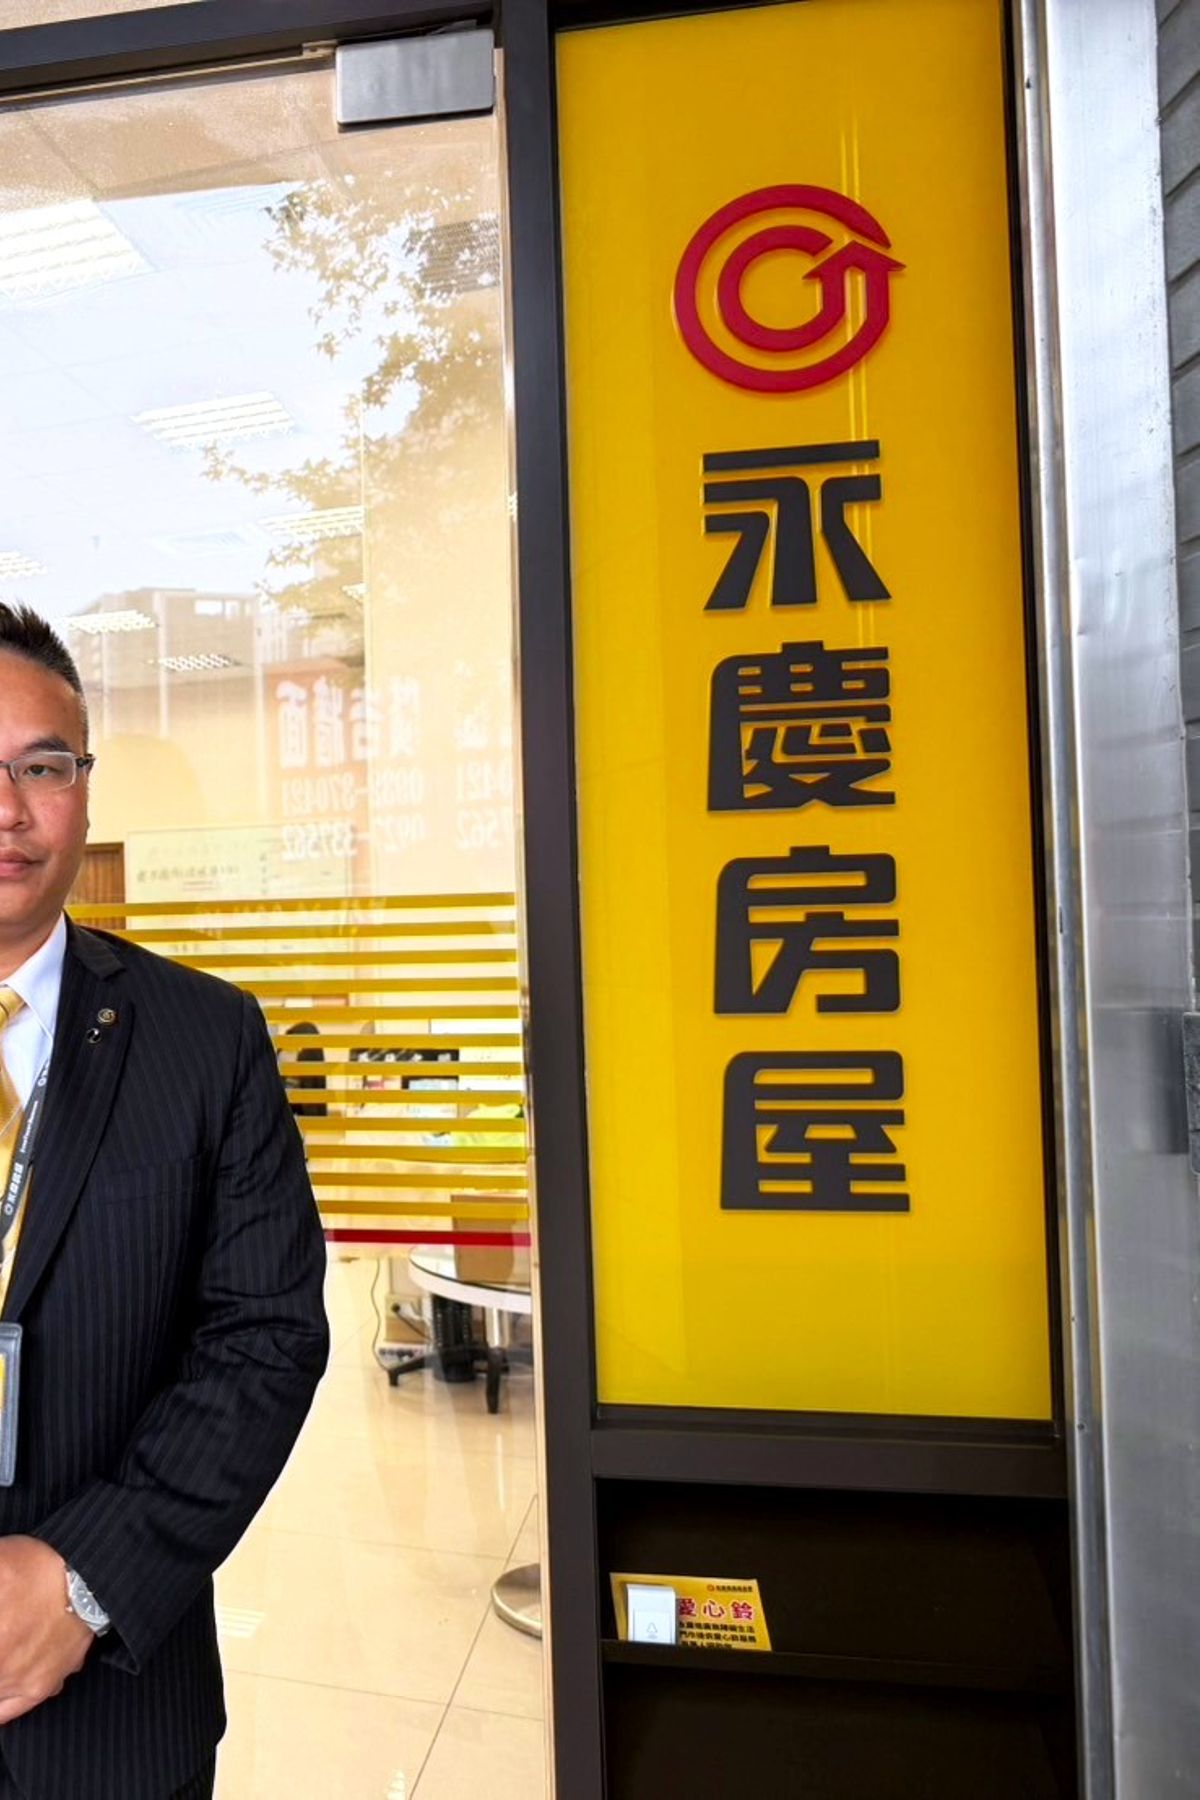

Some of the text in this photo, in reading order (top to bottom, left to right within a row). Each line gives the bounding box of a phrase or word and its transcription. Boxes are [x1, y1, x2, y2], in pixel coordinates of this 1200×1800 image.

[703, 439, 910, 1213] 永慶房屋
[678, 1597, 753, 1621] 愛心鈴
